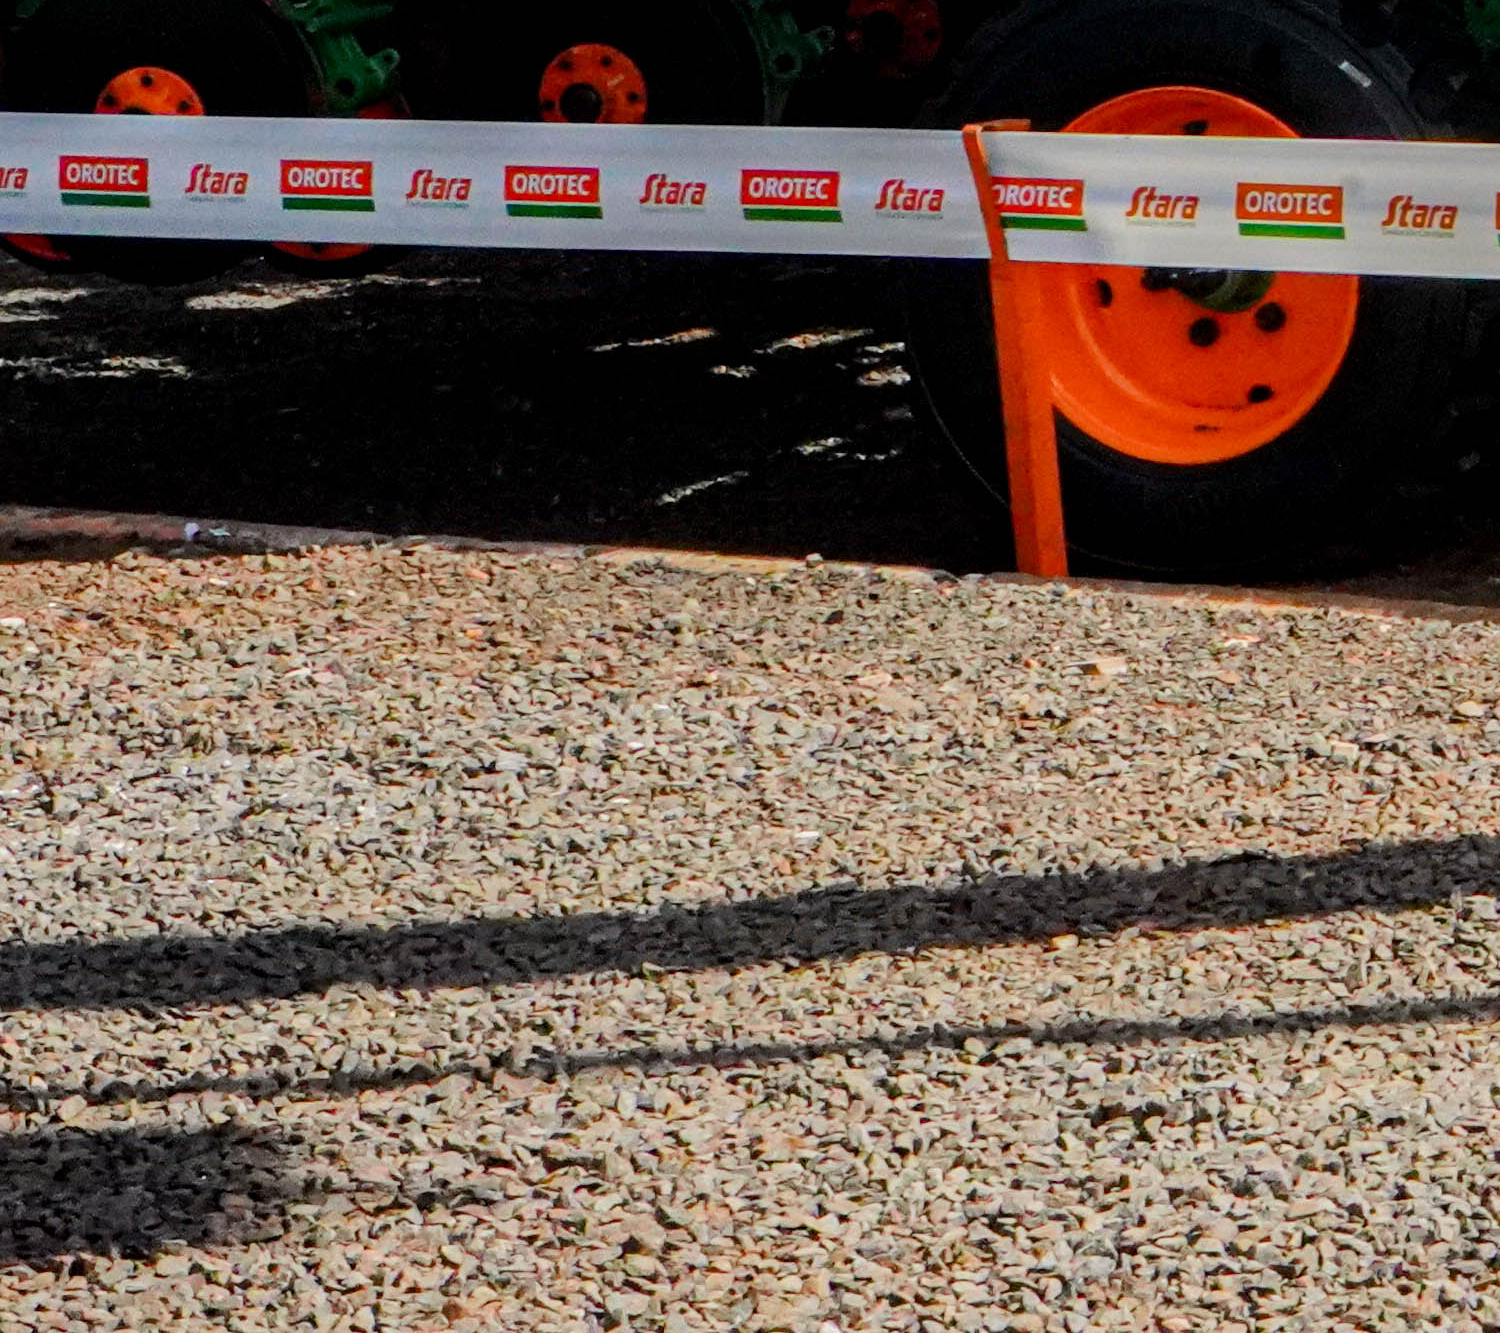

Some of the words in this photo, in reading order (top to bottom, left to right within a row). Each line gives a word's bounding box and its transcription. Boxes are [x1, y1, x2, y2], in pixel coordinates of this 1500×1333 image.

[67, 163, 140, 186] OROTEC
[186, 165, 248, 194] Stara
[289, 167, 363, 190] OROTEC
[407, 170, 470, 200] Stara
[512, 173, 591, 196] OROTEC
[749, 177, 830, 201] OROTEC
[640, 174, 706, 205] Stara
[876, 180, 944, 212] Stara
[1126, 187, 1199, 220] Stara
[1245, 190, 1333, 216] OROTEC
[1382, 195, 1459, 230] Stara
